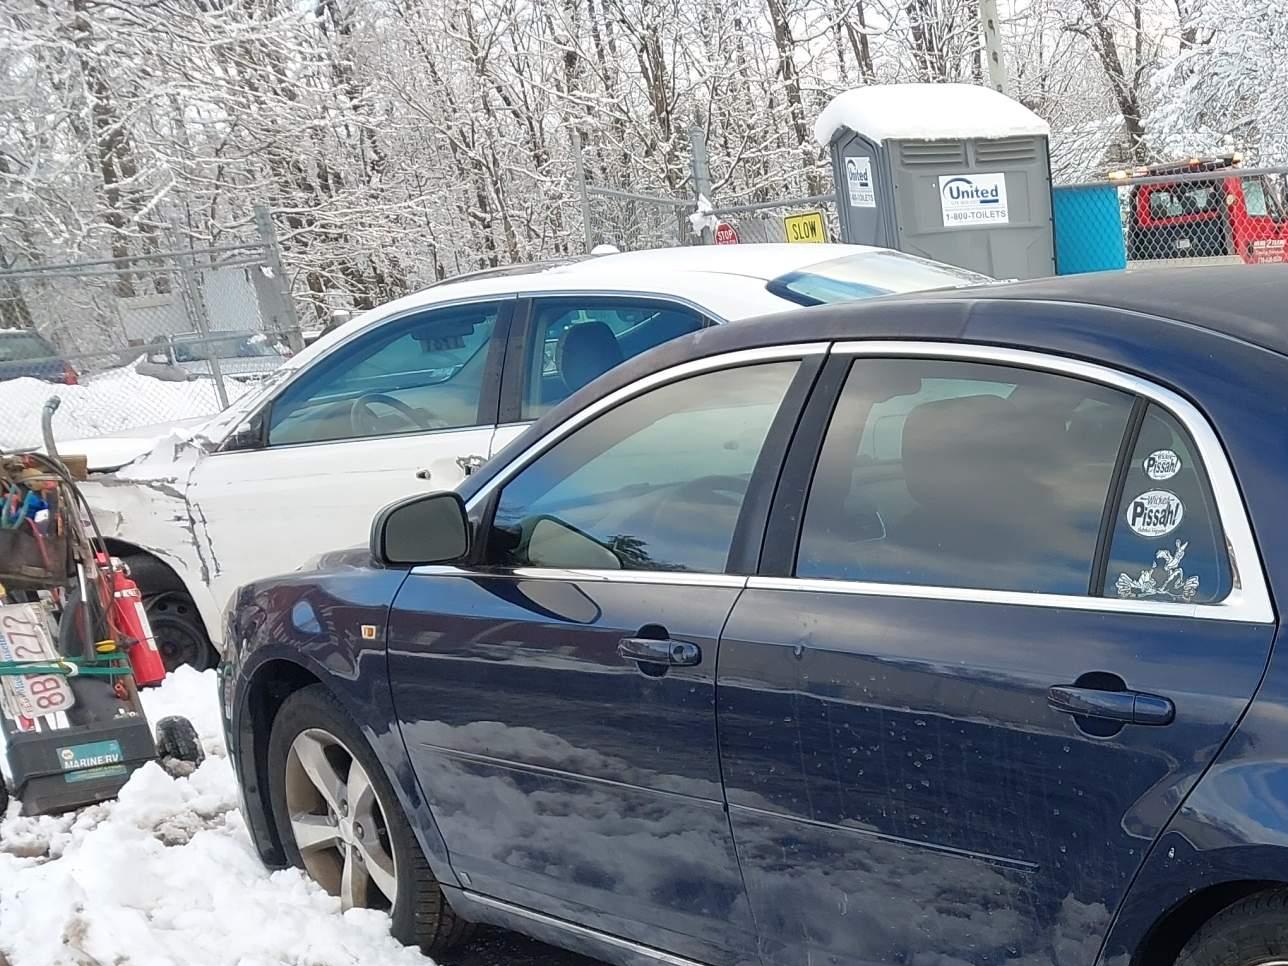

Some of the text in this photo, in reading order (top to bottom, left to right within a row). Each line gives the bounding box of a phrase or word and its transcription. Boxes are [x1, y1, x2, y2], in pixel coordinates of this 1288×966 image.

[848, 167, 868, 182] United
[949, 184, 999, 200] United
[945, 210, 1007, 221] 1-800-TOILETS
[717, 230, 733, 241] STOP
[792, 220, 817, 241] SLOW
[1146, 455, 1179, 474] Pissah!
[1132, 501, 1179, 527] Pissah!
[3, 615, 66, 709] 8B272
[64, 754, 119, 769] MARINE RV
